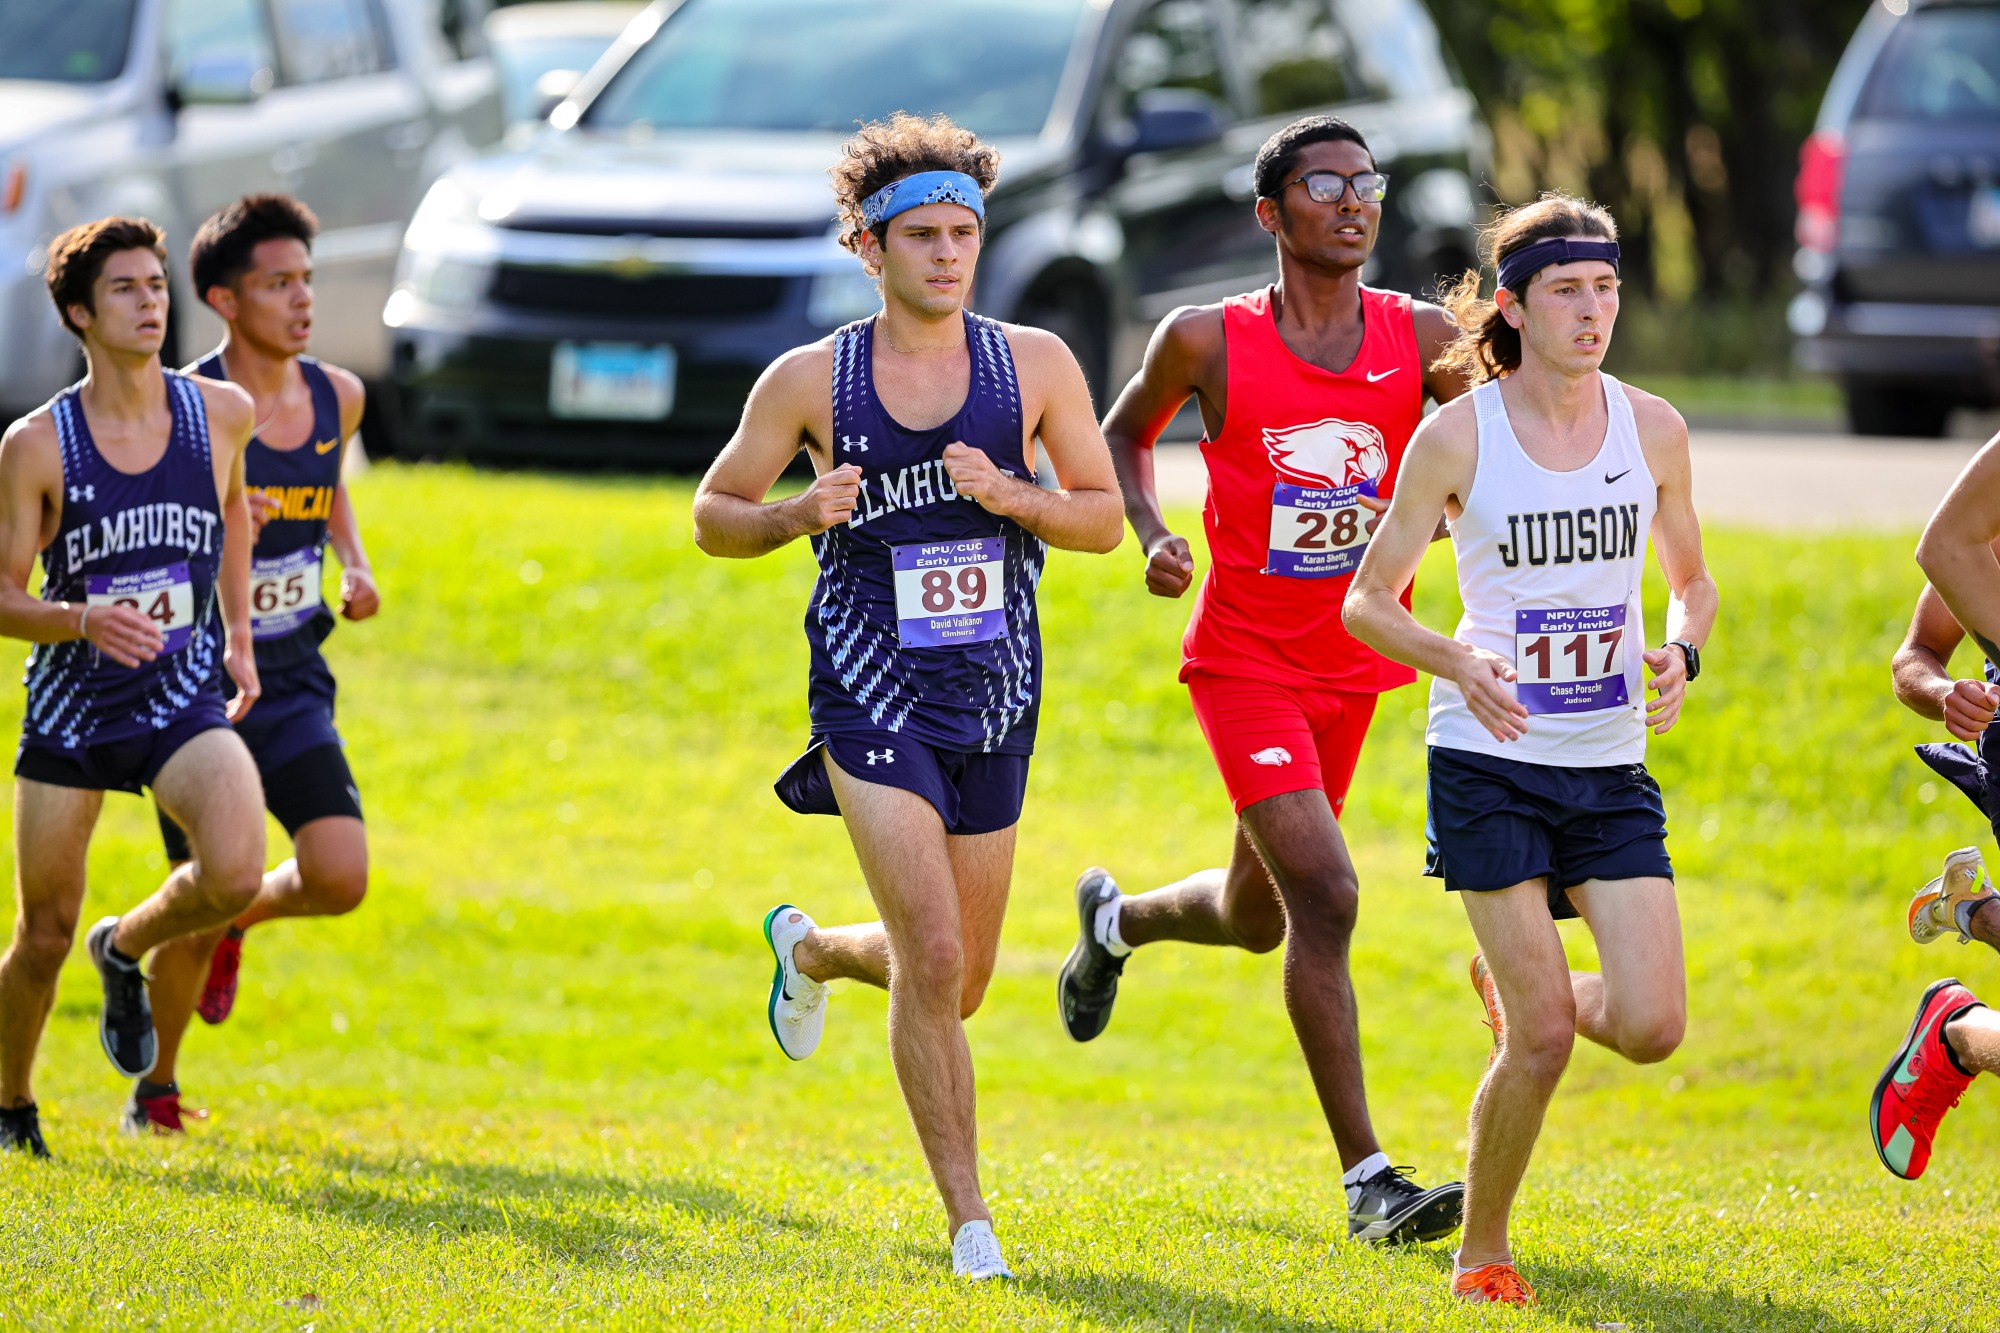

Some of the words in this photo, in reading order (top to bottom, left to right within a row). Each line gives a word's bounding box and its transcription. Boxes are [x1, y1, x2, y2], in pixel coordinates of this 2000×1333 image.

[847, 459, 1015, 530] LMHU
[1301, 486, 1359, 499] NPU/CUC
[1295, 498, 1328, 509] Early
[1331, 496, 1358, 507] Invit
[1293, 508, 1359, 549] 28
[1498, 503, 1639, 568] JUDSON
[65, 502, 217, 575] ELMHURST
[921, 542, 983, 555] NPU/CUC
[916, 557, 949, 567] Early
[953, 553, 988, 564] Invite
[1303, 555, 1325, 564] Karan
[1326, 552, 1348, 563] Shetty
[1293, 564, 1339, 573] Benedictine
[253, 573, 304, 612] 65
[921, 566, 987, 613] 89
[113, 590, 176, 626] 4
[1546, 608, 1610, 621] NPU/CUC
[930, 618, 952, 630] David
[953, 616, 983, 628] Valkanov
[1540, 622, 1574, 632] Early
[1578, 620, 1614, 630] Invite
[941, 628, 976, 638] Elmhurst
[1525, 628, 1623, 679] 117
[1550, 685, 1574, 696] Chase
[1575, 682, 1603, 694] Porsche
[1563, 697, 1592, 705] Judson
